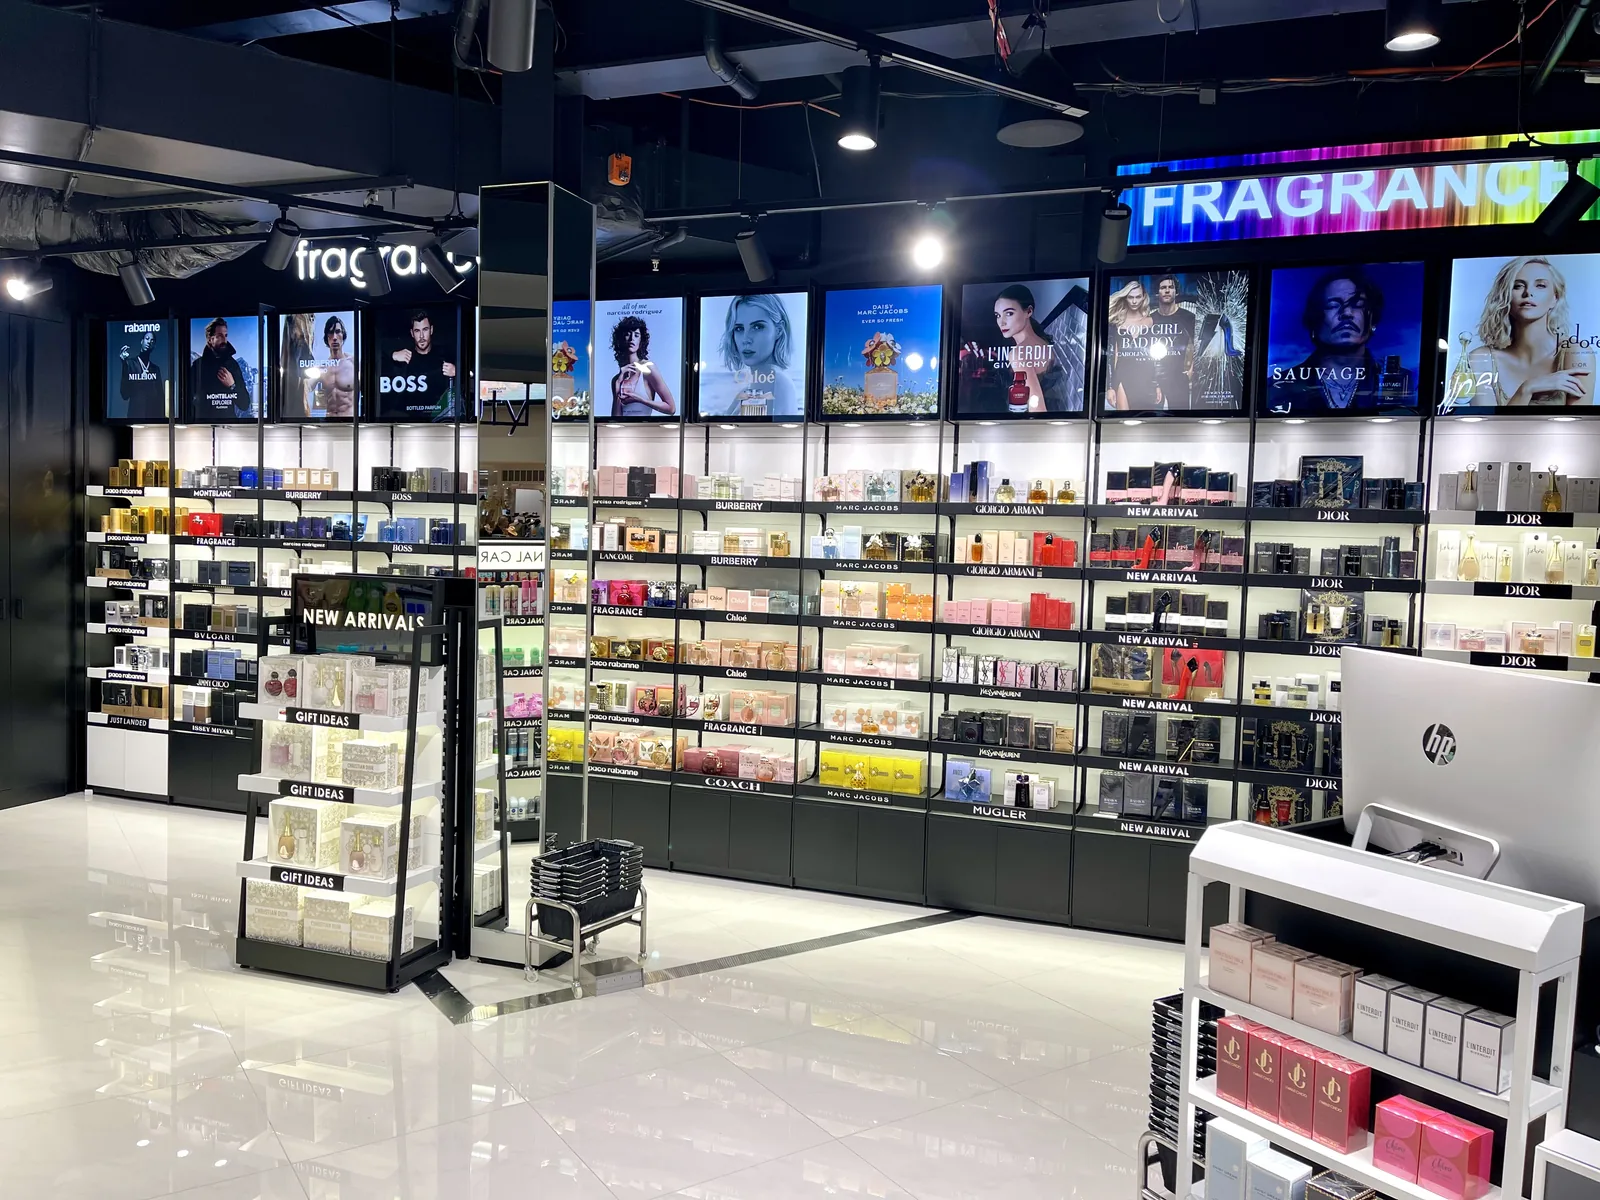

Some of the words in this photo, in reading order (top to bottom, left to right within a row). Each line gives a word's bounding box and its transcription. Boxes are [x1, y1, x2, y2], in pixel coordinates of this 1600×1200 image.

[124, 322, 160, 333] rabanne
[1118, 325, 1149, 336] GOOD
[1150, 323, 1182, 335] GIRL
[1122, 338, 1149, 350] BAD
[988, 344, 1054, 363] L'INTERDIT
[300, 358, 340, 368] BURBERRY
[993, 360, 1047, 369] GIVENCHY
[1272, 366, 1366, 380] SAUVAGE
[380, 374, 428, 393] BOSS
[105, 488, 120, 496] paco
[194, 490, 232, 498] MONTBLANC
[286, 492, 322, 500] BURBERRY
[716, 501, 763, 510] BURBERRY
[976, 505, 1010, 514] GIORGIO
[1011, 506, 1044, 514] ARMANI
[1128, 508, 1150, 516] NEW
[1153, 508, 1198, 517] ARRIVAL
[1317, 510, 1350, 520] DIOR
[1506, 514, 1542, 524] DIOR
[196, 538, 236, 546] FRAGRANCE
[711, 557, 758, 566] BURBERRY
[966, 566, 1000, 575] GIORGIO
[998, 567, 1034, 576] ARMANI
[1126, 572, 1150, 580] NEW
[1152, 572, 1198, 582] ARRIVAL
[123, 580, 146, 588] rabanne
[1311, 578, 1343, 588] DIOR
[1505, 585, 1540, 596] DIOR
[593, 606, 642, 616] FRAGRANCE
[303, 608, 339, 626] NEW
[344, 611, 424, 632] ARRIVALS
[726, 613, 747, 621] Chloé
[194, 632, 235, 641] BVLGARI
[972, 627, 1006, 636] GIORGIO
[1008, 629, 1040, 639] ARMANI
[1118, 635, 1141, 644] NEW
[1144, 636, 1189, 647] ARRIVAL
[1309, 645, 1340, 656] DIOR
[608, 661, 640, 669] rabanne
[1501, 655, 1536, 667] DIOR
[726, 669, 747, 678] Chloé
[212, 680, 229, 688] CHOO
[1122, 699, 1145, 708] NEW
[1148, 701, 1193, 712] ARRIVAL
[124, 718, 147, 727] LANDED
[296, 711, 317, 723] GIFT
[320, 714, 350, 726] IDEAS
[608, 714, 640, 723] rabanne
[1310, 712, 1341, 723] DIOR
[211, 727, 234, 735] MIYAKE
[704, 722, 757, 734] FRAGRANCE
[857, 738, 892, 746] JACOBS
[1423, 722, 1455, 766] hp
[607, 767, 638, 776] rabanne
[1119, 761, 1142, 771] NEW
[1144, 764, 1189, 775] ARRIVAL
[705, 778, 760, 791] COACH
[1306, 778, 1338, 790] DIOR
[290, 784, 312, 796] GIFT
[314, 787, 344, 800] IDEAS
[973, 806, 1026, 819] MUGLER
[1121, 823, 1144, 832] NEW
[1146, 826, 1190, 838] ARRIVAL
[280, 871, 302, 884] GIFT
[304, 874, 334, 888] IDEAS
[1357, 1003, 1382, 1018] L'INTERDIT
[1392, 1016, 1419, 1031] L'INTERDIT
[1428, 1028, 1457, 1043] L'INTERDIT
[1466, 1041, 1496, 1056] L'INTERDIT
